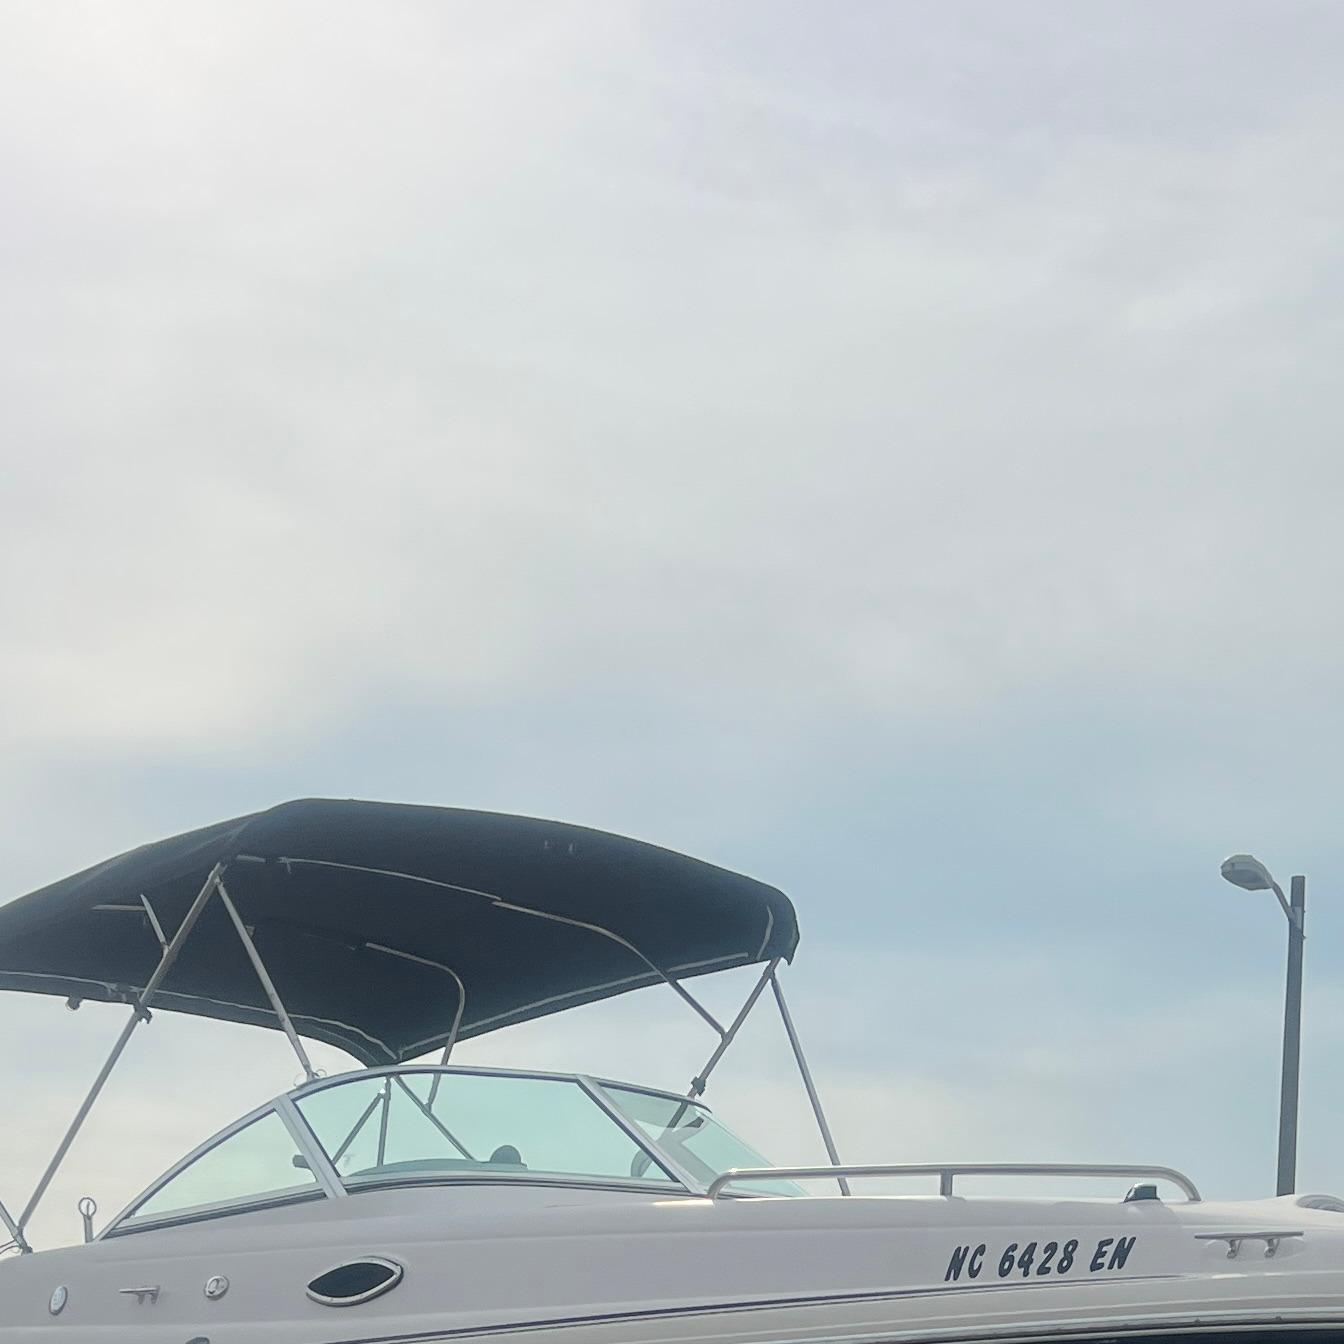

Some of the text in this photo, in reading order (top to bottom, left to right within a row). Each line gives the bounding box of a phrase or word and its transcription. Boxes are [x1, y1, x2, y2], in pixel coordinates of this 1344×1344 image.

[944, 1236, 1137, 1282] NC 6428 EN
